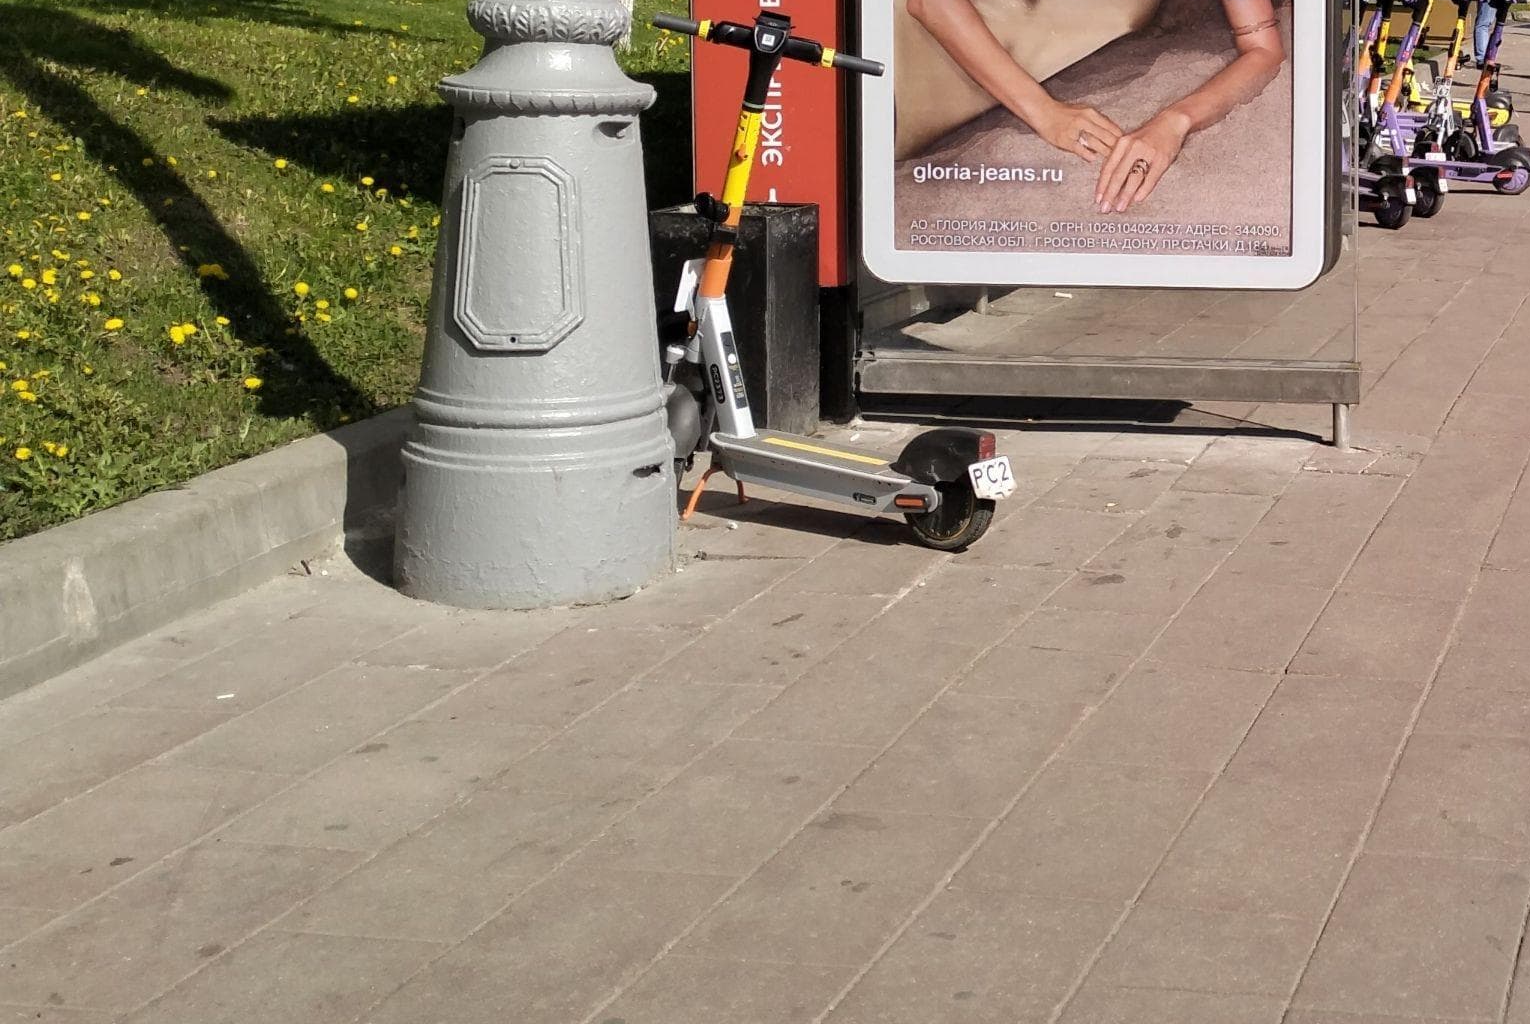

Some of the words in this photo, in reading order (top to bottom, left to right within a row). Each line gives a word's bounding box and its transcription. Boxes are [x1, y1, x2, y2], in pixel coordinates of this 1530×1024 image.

[913, 162, 1063, 184] gloria-jeans.ru
[910, 219, 928, 230] АО
[1050, 222, 1083, 233] ОГРН
[1185, 225, 1232, 237] АДРЕС:
[1235, 225, 1282, 238] 344090,
[910, 234, 995, 246] РОСТОВСКАЯ
